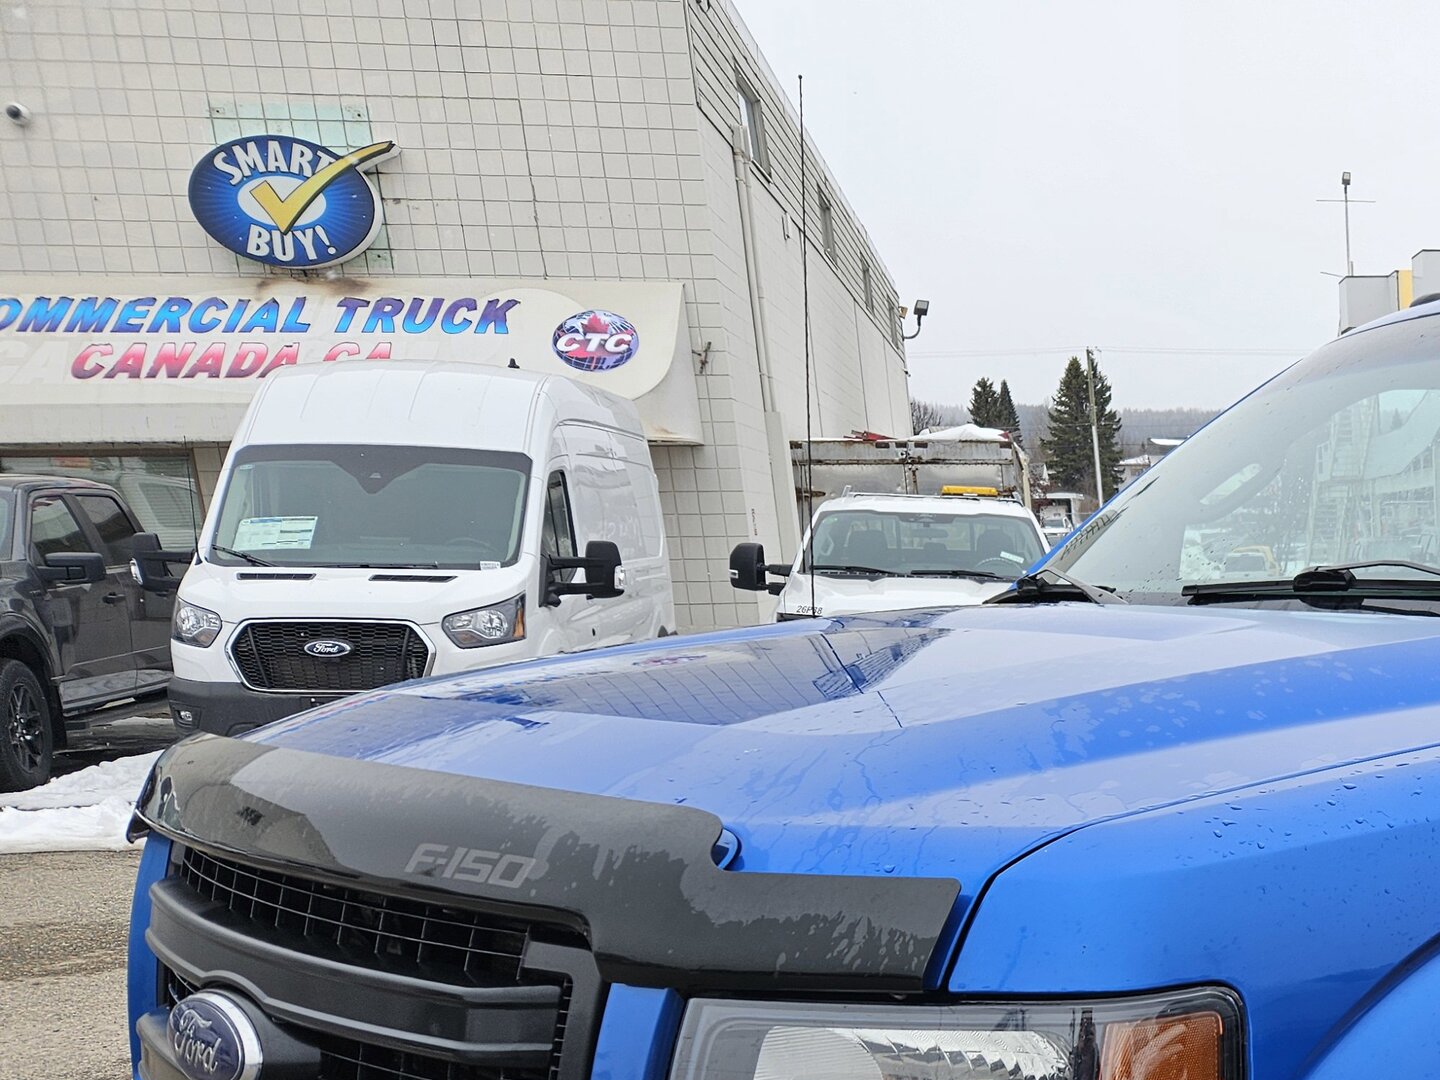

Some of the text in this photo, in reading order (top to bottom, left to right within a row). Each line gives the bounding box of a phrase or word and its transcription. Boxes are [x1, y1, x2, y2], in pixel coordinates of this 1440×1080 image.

[213, 140, 337, 186] SMART
[246, 223, 337, 262] BUY!
[335, 297, 521, 335] TRUCK
[71, 342, 300, 379] CANADA
[556, 332, 632, 354] CTC
[313, 643, 340, 653] Ford
[404, 843, 537, 889] F-150
[174, 1009, 222, 1075] Ford
